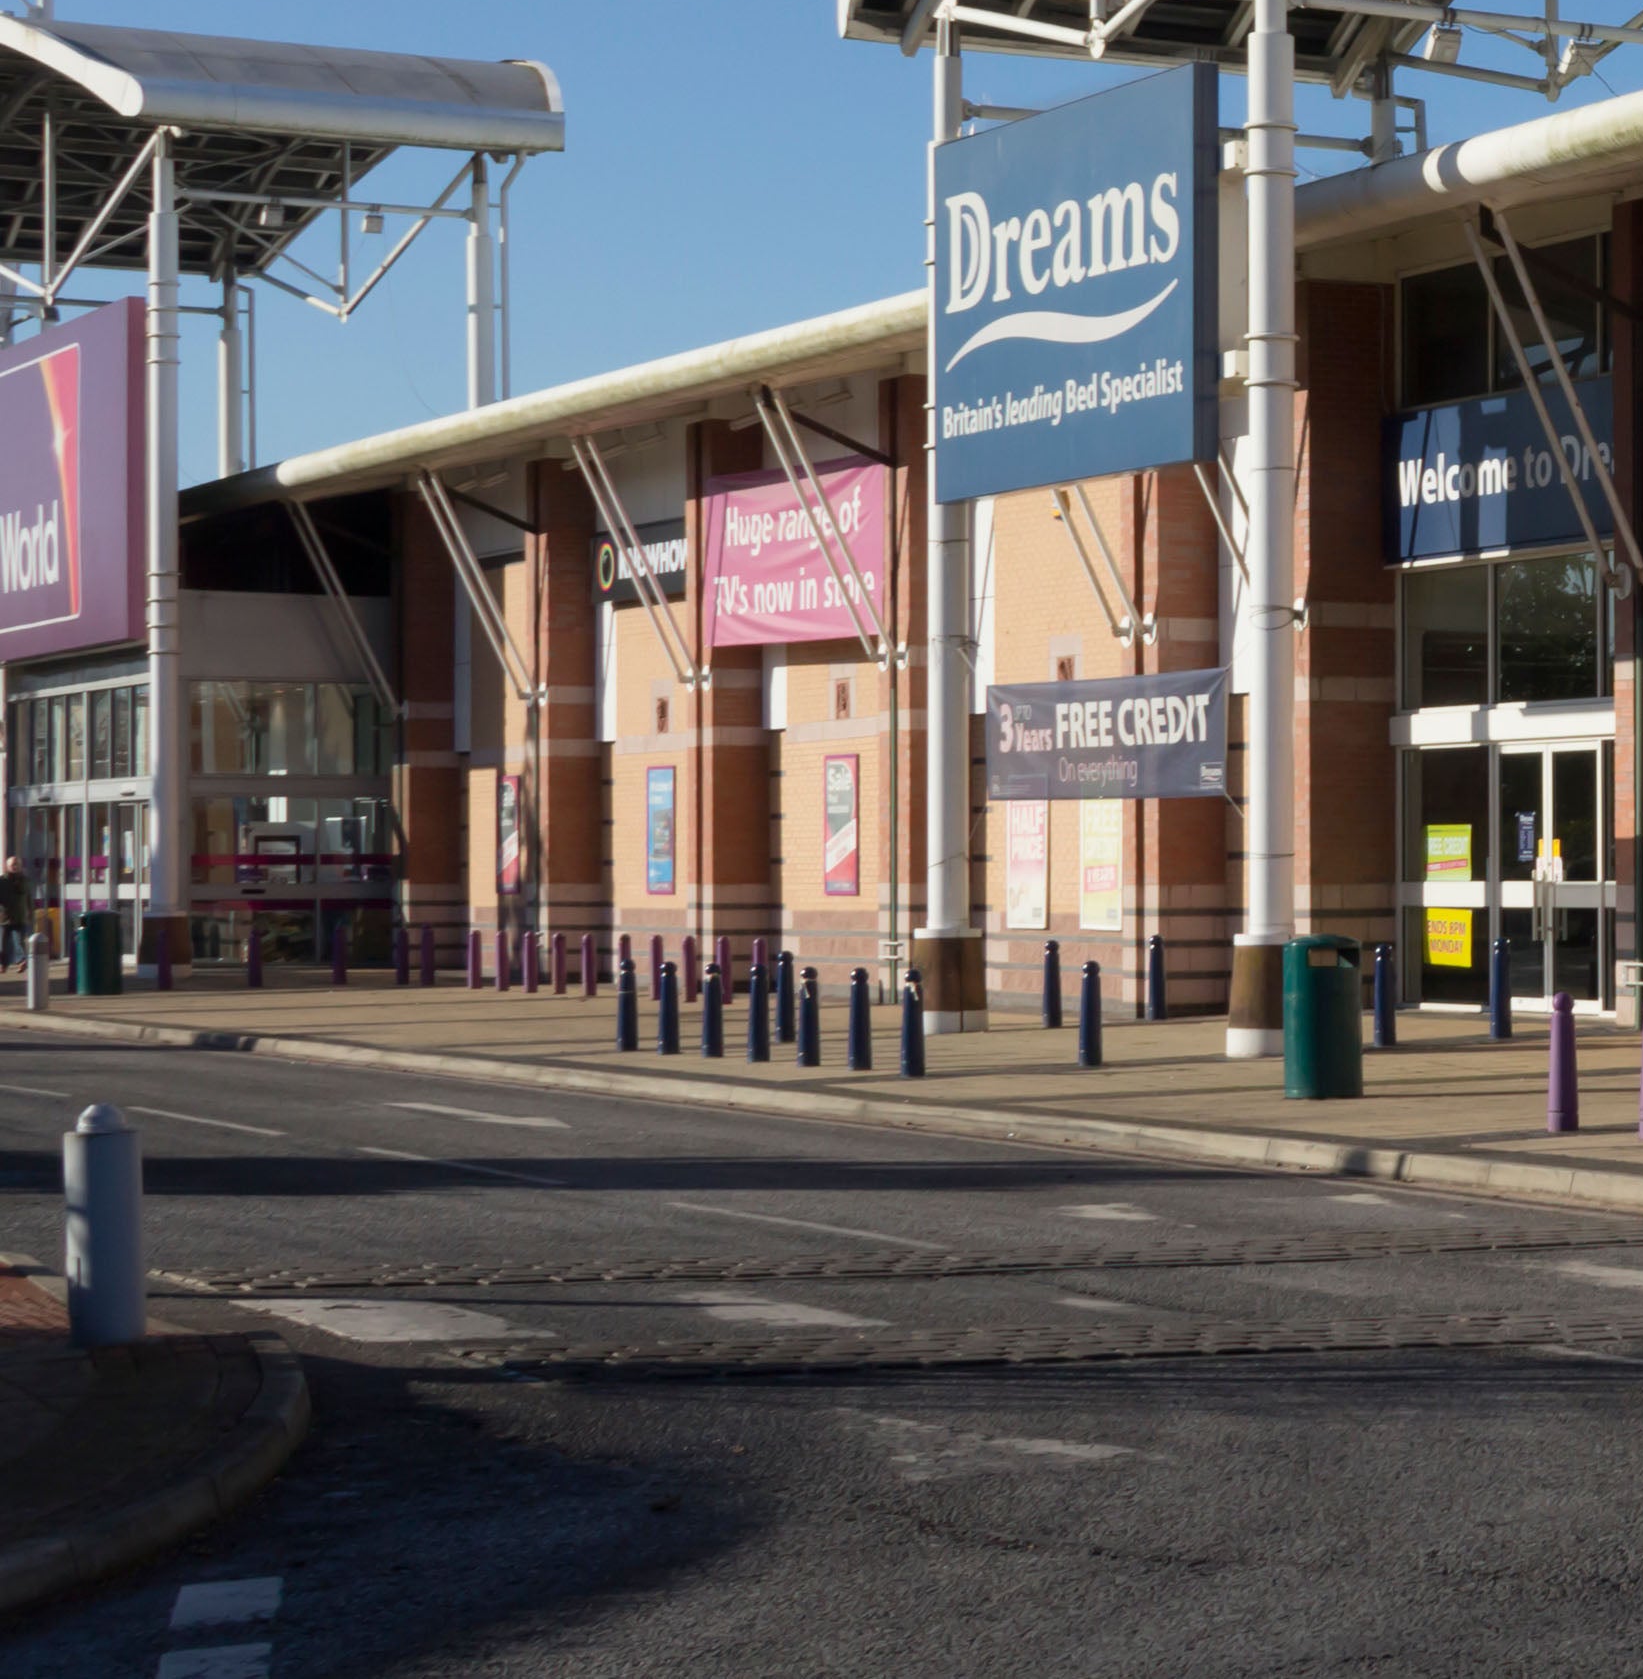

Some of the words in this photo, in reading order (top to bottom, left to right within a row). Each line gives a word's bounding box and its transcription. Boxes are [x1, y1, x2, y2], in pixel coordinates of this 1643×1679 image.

[945, 171, 1180, 314] Dreams
[943, 395, 1003, 439] Britain's
[1005, 384, 1063, 426] leading
[1065, 372, 1098, 413] Bed
[1100, 358, 1184, 414] Specialist
[1399, 452, 1517, 507] Welcome
[1523, 445, 1553, 489] to
[1559, 435, 1614, 485] Dre
[0, 499, 59, 594] World
[726, 506, 772, 557] Huge
[778, 508, 834, 549] range
[839, 485, 862, 533] of
[714, 575, 749, 616] TV's
[753, 581, 795, 614] now
[800, 568, 817, 611] in
[823, 571, 876, 608] store
[999, 703, 1014, 753] 3
[1014, 723, 1053, 752] Years
[1055, 700, 1115, 749] FREE
[1117, 693, 1210, 746] CREDIT
[1058, 756, 1076, 782] On
[1077, 753, 1139, 787] everything
